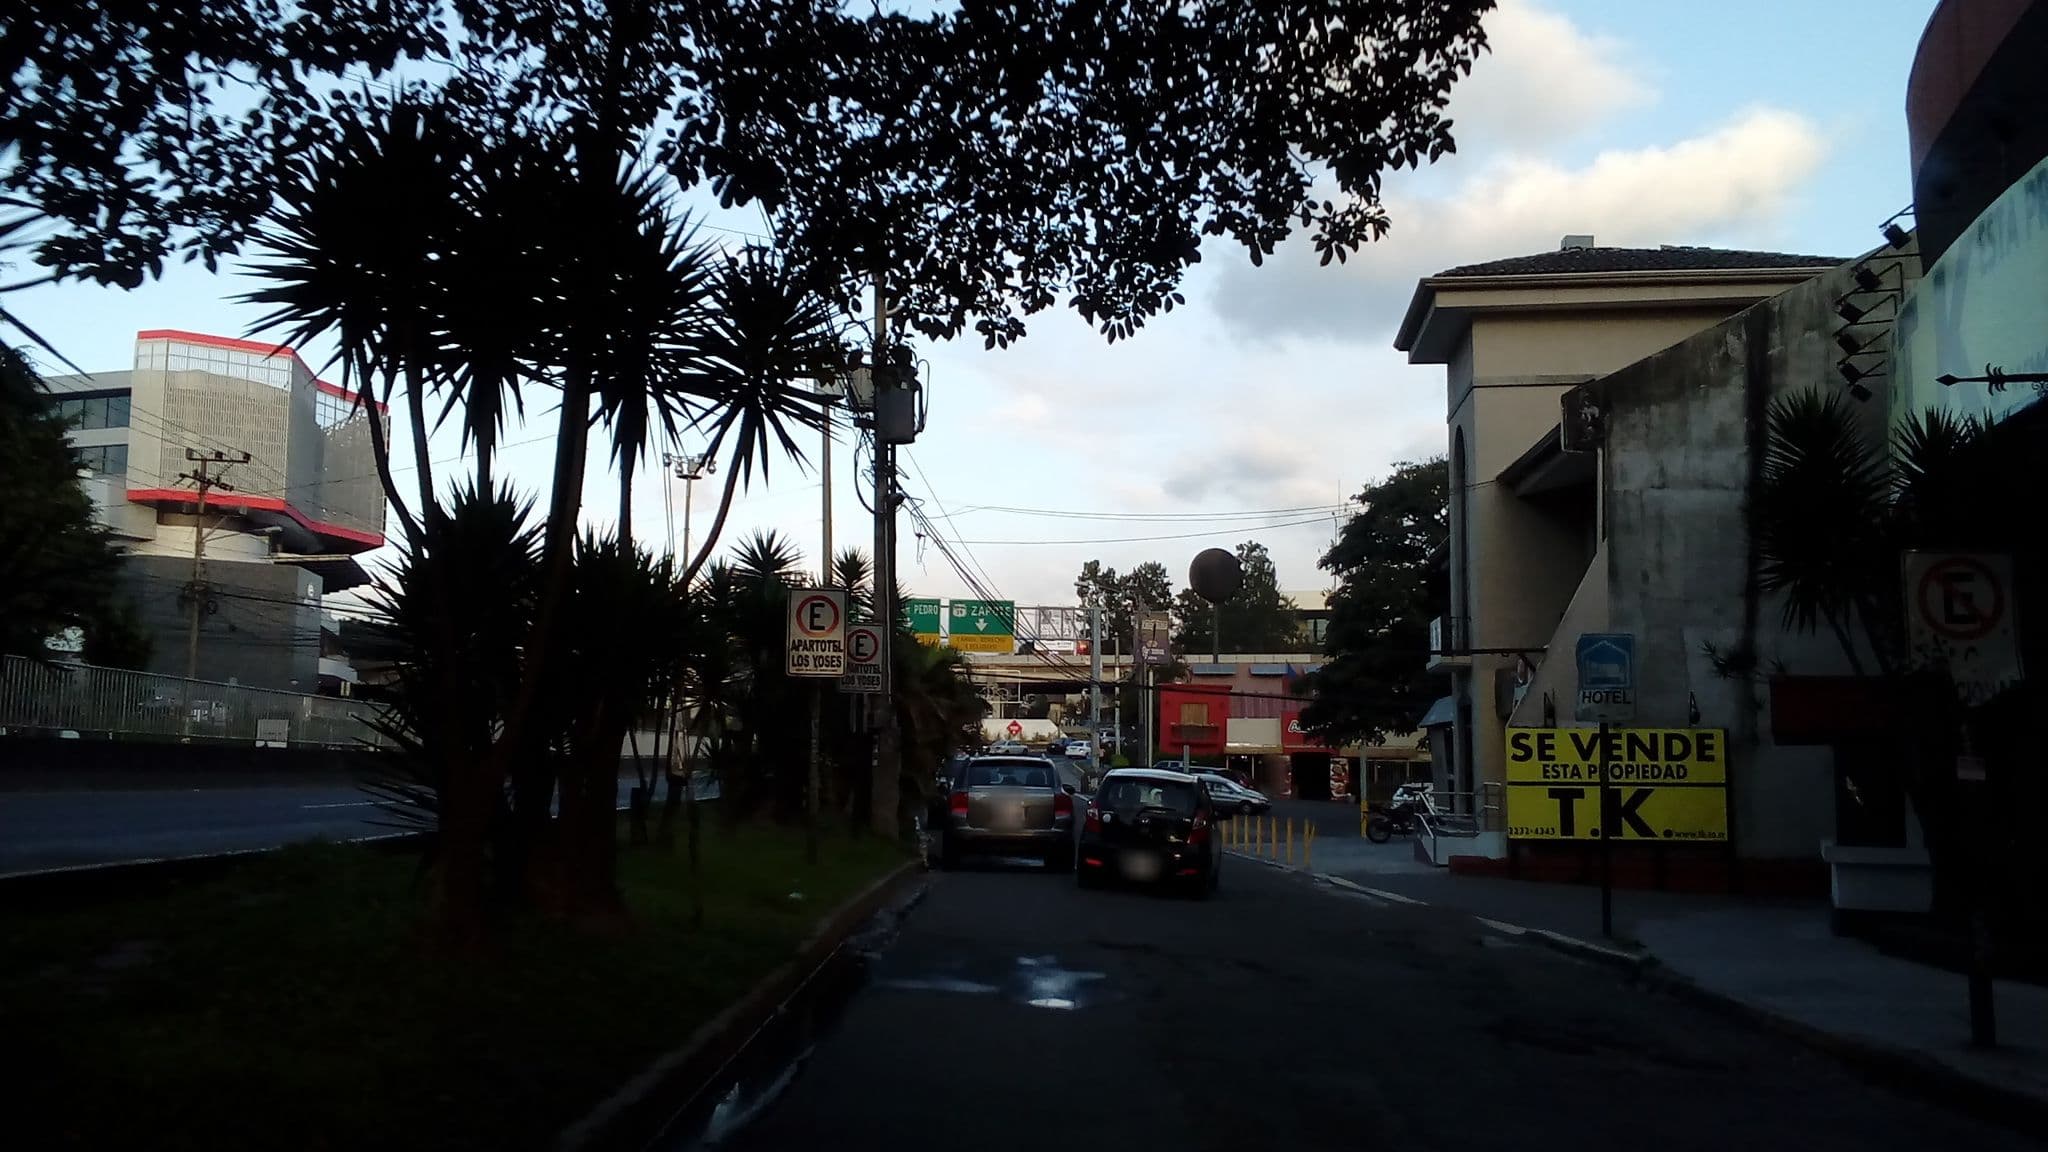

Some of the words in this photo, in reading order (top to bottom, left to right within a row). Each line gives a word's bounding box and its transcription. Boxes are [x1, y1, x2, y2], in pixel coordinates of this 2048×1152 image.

[809, 602, 825, 630] E
[913, 604, 938, 615] PEDRO
[971, 606, 1011, 616] ZAP
[791, 640, 843, 652] APARTOTEL
[855, 635, 868, 657] E
[791, 655, 810, 667] LOS
[812, 655, 842, 668] YOSES
[1582, 690, 1632, 704] HOTEL
[1511, 732, 1555, 762] SE
[1569, 732, 1715, 762] VENDE
[1542, 764, 1579, 779] ESTA
[1588, 764, 1688, 780] POPIEDAD
